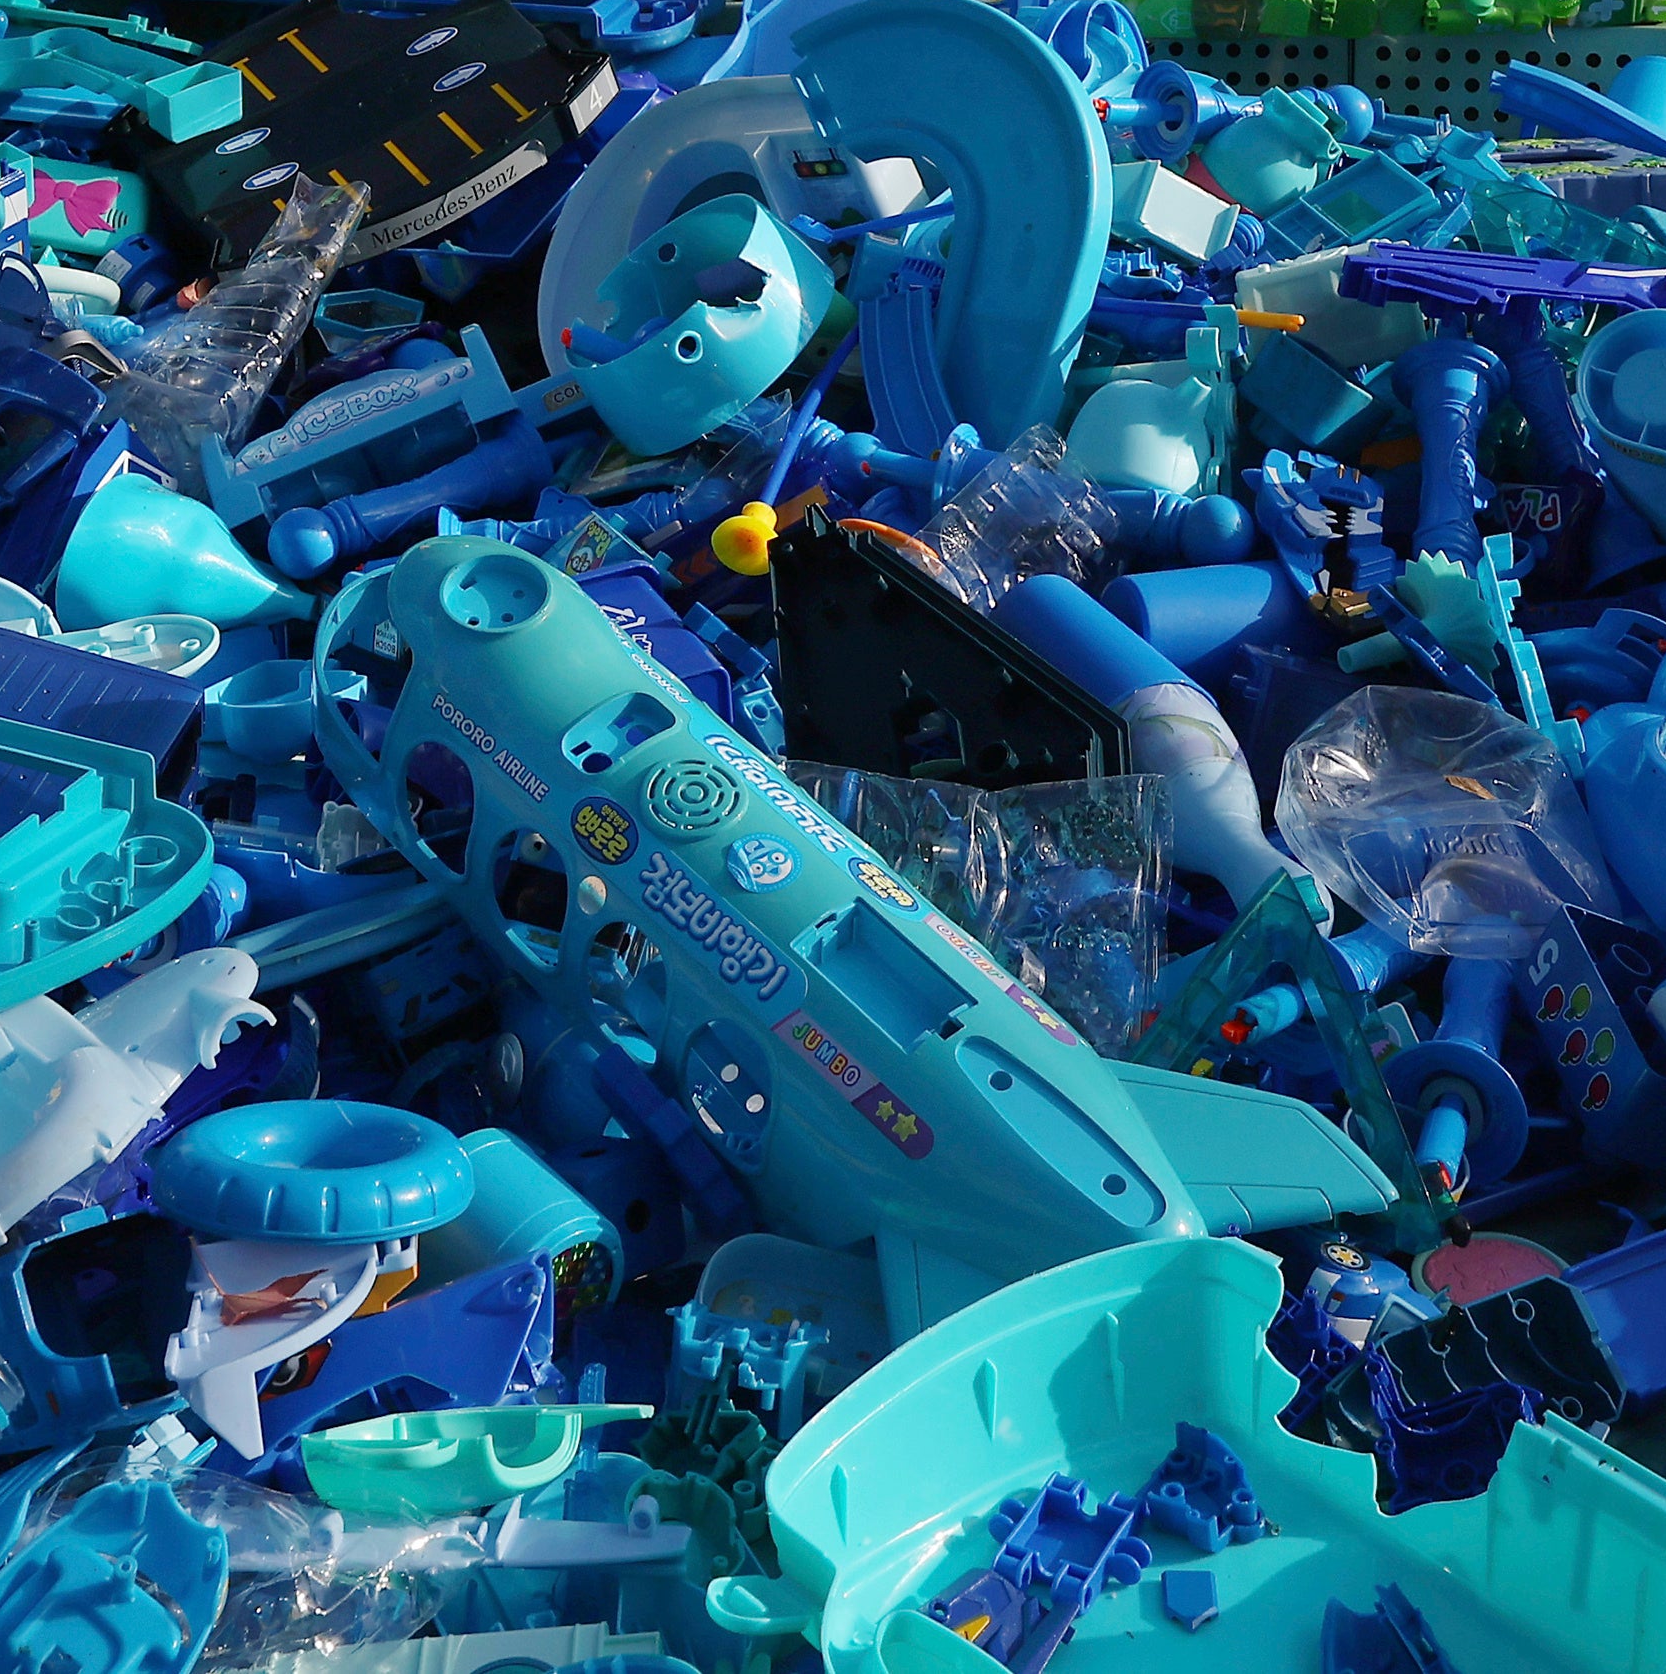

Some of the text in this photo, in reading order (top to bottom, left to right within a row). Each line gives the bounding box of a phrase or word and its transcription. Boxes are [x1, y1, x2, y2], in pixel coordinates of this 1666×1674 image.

[590, 83, 604, 111] 4
[370, 163, 519, 249] Mercedes-Benz
[345, 374, 422, 427] BOX
[376, 640, 397, 653] BOSCH
[631, 652, 690, 704] PORORO
[431, 692, 551, 804] PORORO AIRLINE
[704, 732, 852, 855] 점보비행기
[640, 851, 790, 1003] 점보비행기
[936, 922, 1009, 988] JUMBO
[790, 1021, 863, 1090] JUMBO
